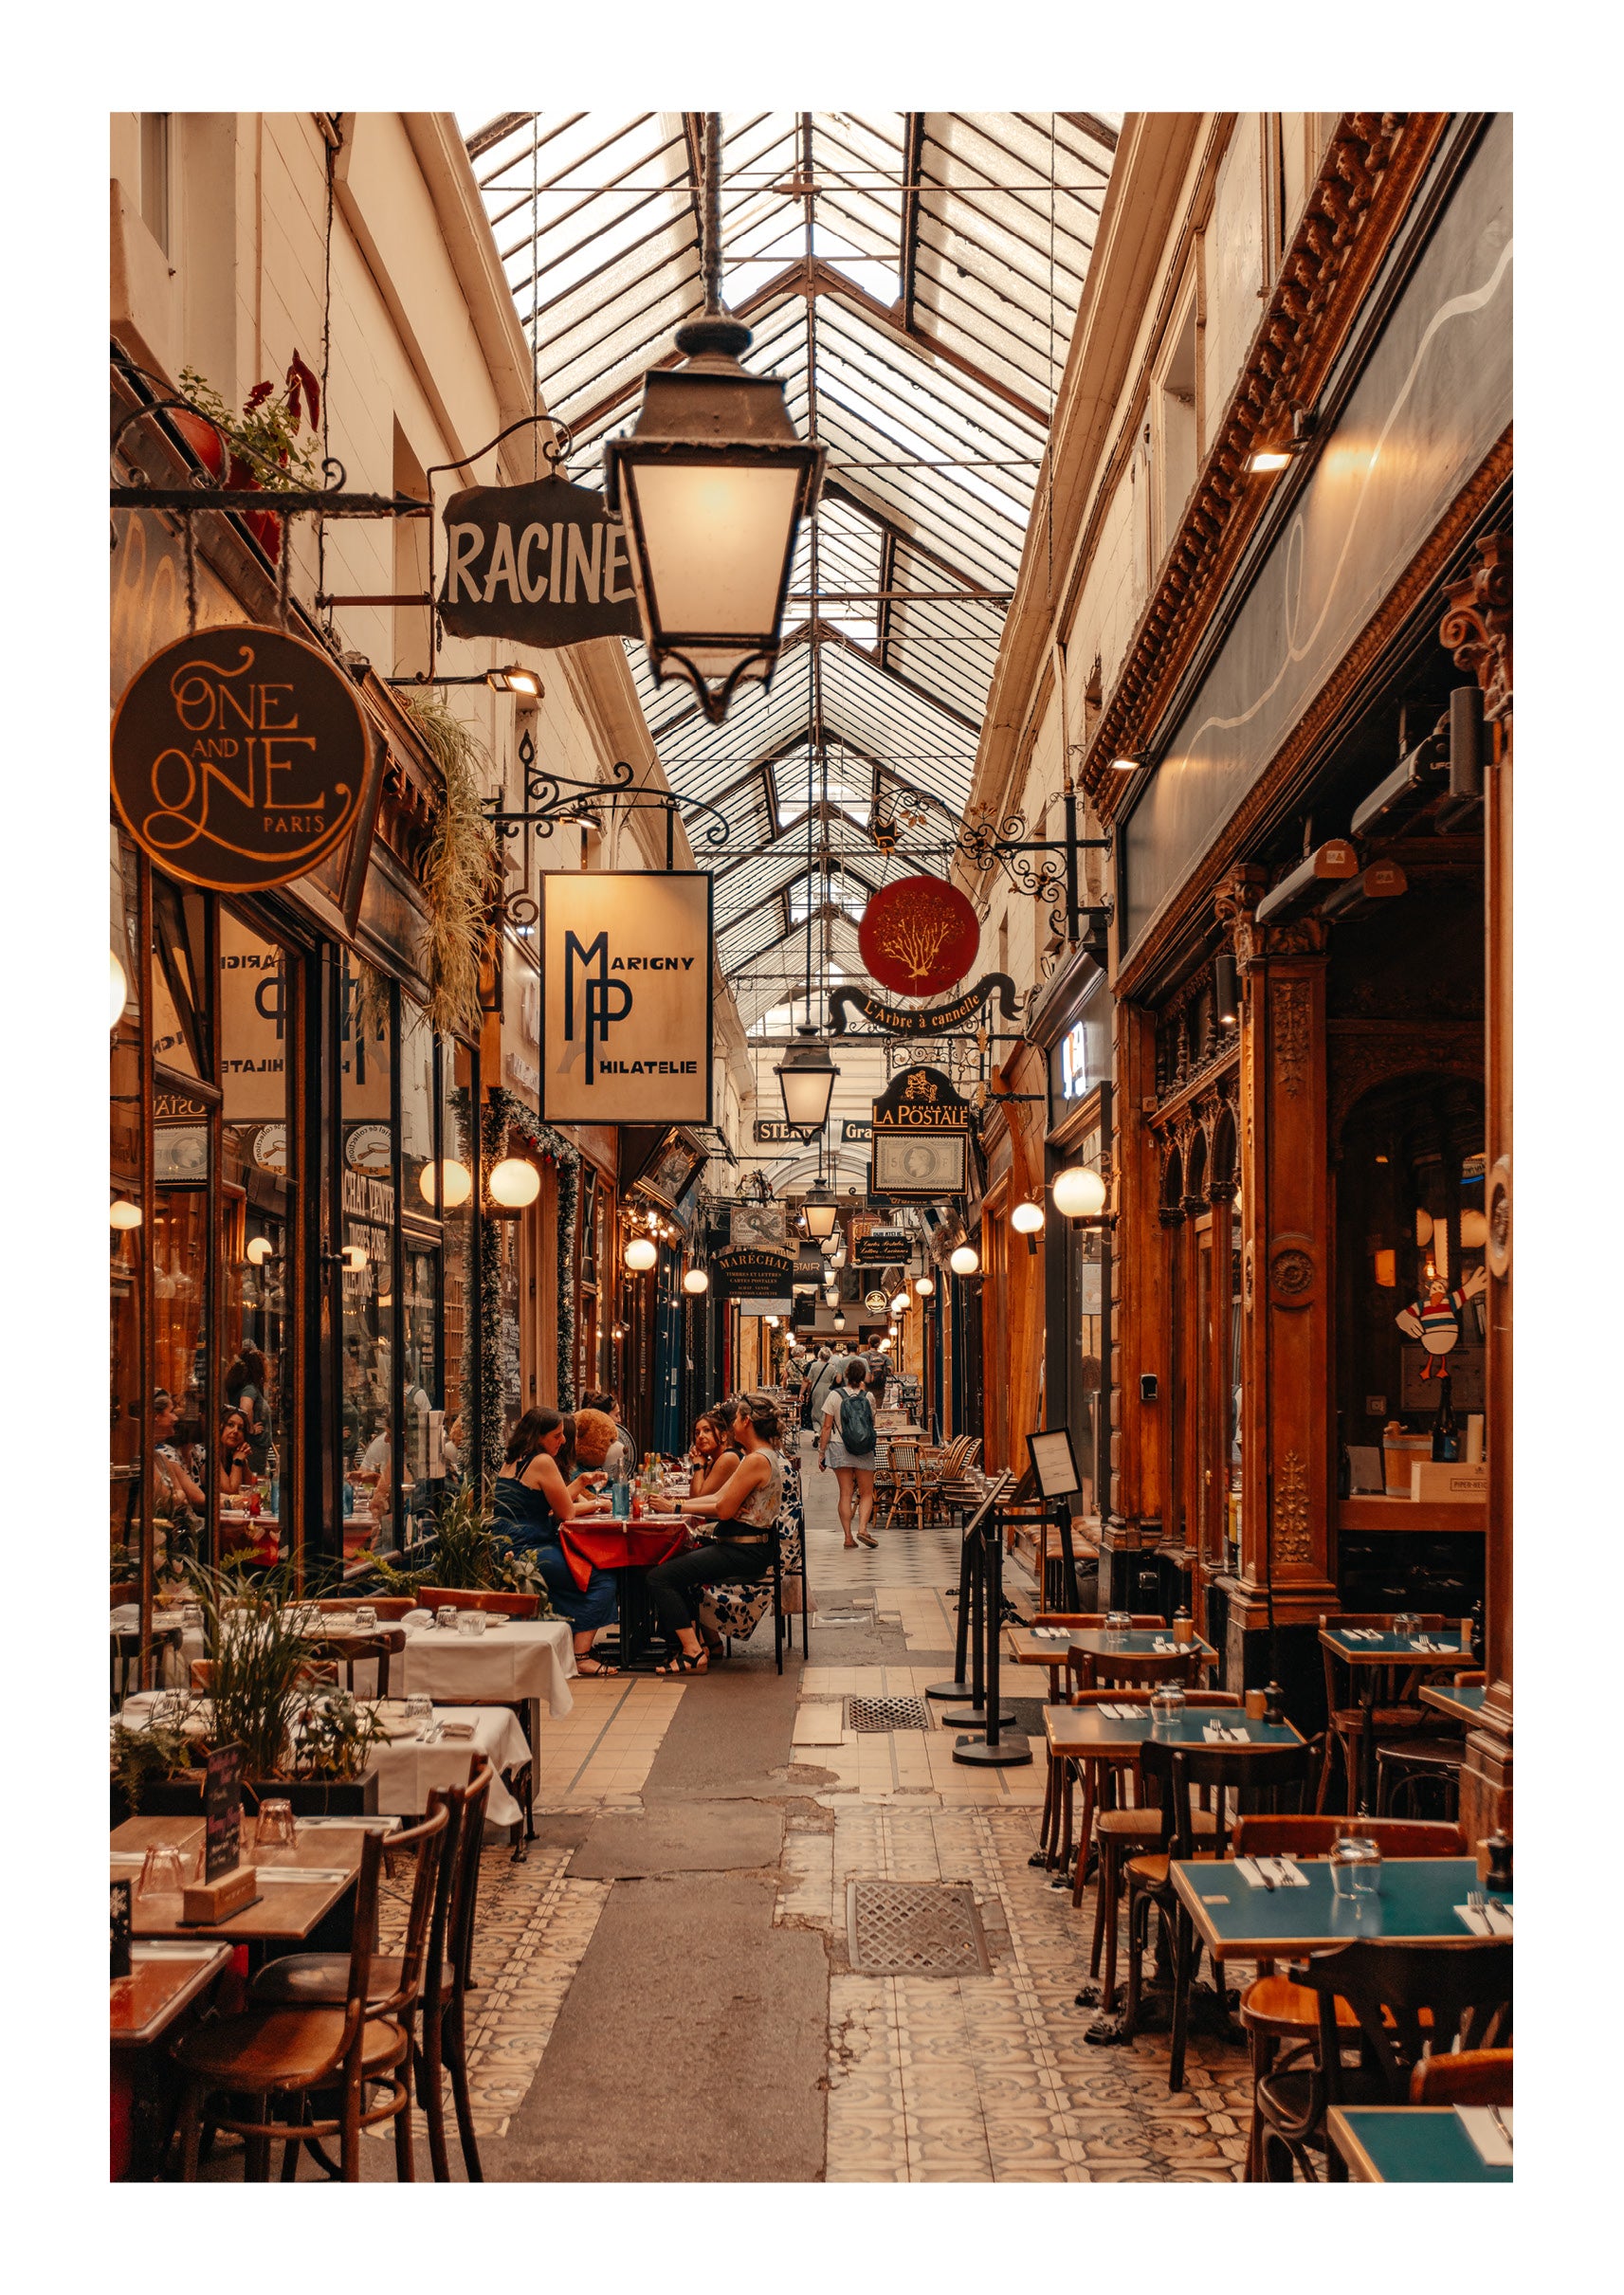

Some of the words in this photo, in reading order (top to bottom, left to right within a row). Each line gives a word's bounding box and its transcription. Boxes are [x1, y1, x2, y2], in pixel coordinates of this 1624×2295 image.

[447, 521, 637, 605] RACINE
[171, 647, 300, 732] ONE
[191, 736, 239, 759] AND
[264, 815, 326, 834] PARIS
[864, 999, 913, 1029] L'Arbre
[919, 1014, 926, 1029] à
[932, 994, 980, 1027] cannelle
[873, 1105, 894, 1124] LA
[898, 1105, 968, 1125] POSTALE
[720, 1252, 790, 1271] MARÉCHAL
